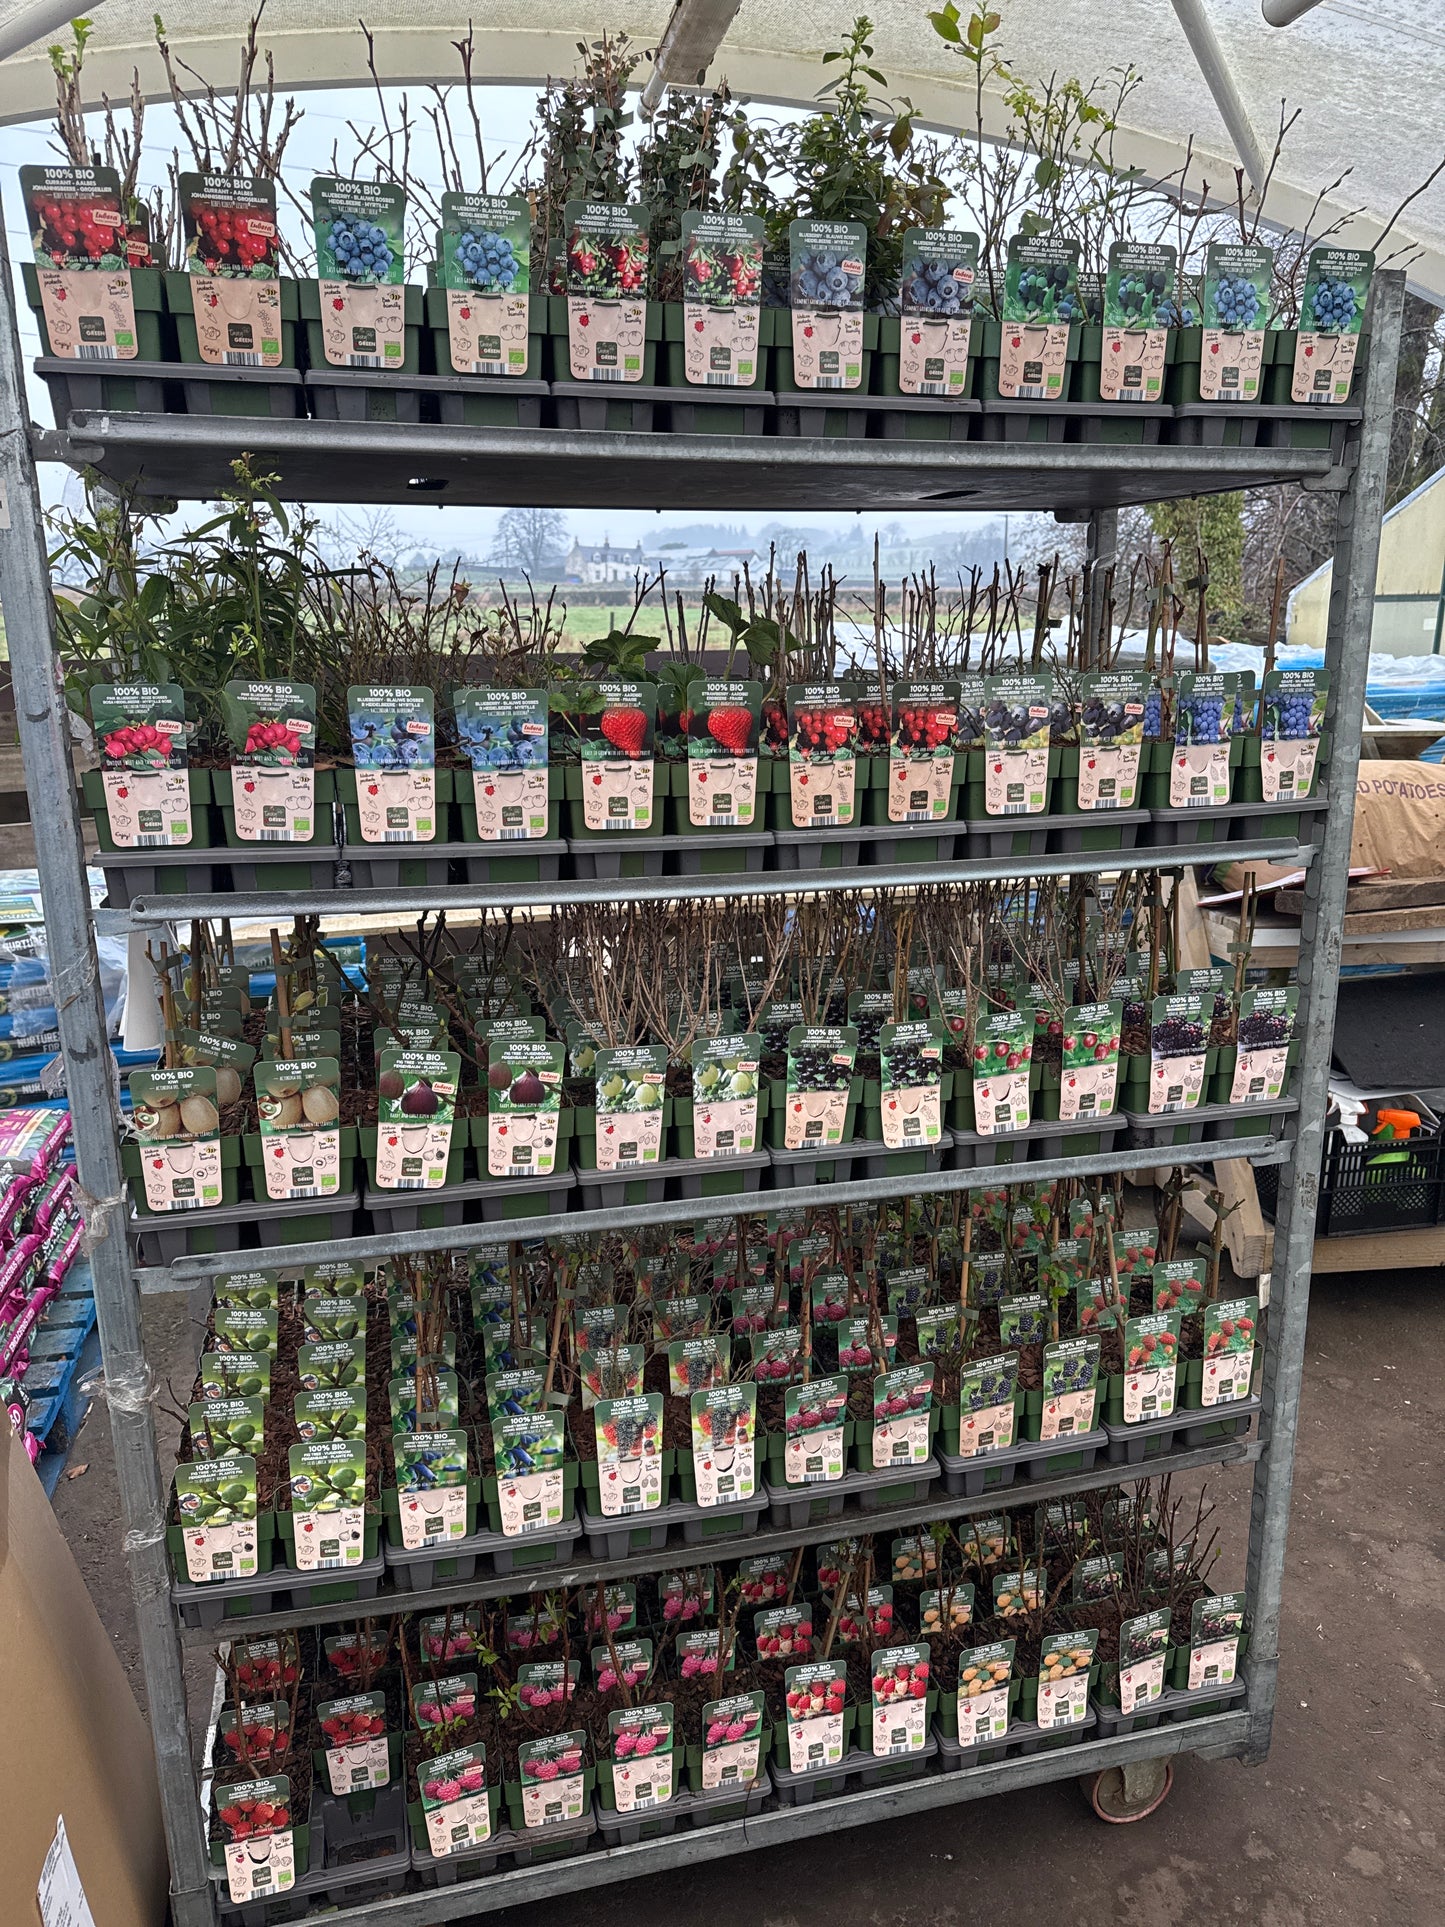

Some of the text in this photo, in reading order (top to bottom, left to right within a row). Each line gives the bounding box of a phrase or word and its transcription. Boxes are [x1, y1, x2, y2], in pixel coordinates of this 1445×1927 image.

[44, 168, 95, 180] 100% BIO
[203, 177, 253, 190] 100% BIO
[335, 182, 381, 196] 100% BIO
[464, 196, 509, 209] 100% BIO
[586, 204, 628, 217] 100% BIO
[702, 215, 743, 227] 100% BIO
[810, 224, 848, 234] 100% BIO
[925, 231, 962, 243] 100% BIO
[1028, 237, 1064, 248] 100% BIO
[1128, 244, 1161, 255] 100% BIO
[1225, 247, 1258, 257] 100% BIO
[1328, 251, 1360, 262] 100% BIO
[1100, 675, 1134, 684] 100% BIO
[1212, 675, 1224, 683] BIO
[1302, 671, 1314, 679] BIO
[1002, 677, 1036, 686] 100% BIO
[113, 687, 159, 696] 100% BIO
[248, 685, 293, 694] 100% BIO
[622, 685, 637, 693] BIO
[706, 684, 744, 692] 100% BIO
[805, 686, 840, 695] 100% BIO
[910, 684, 945, 693] 100% BIO
[369, 689, 412, 697] 100% BIO
[486, 692, 527, 701] 100% BIO
[1372, 779, 1445, 800] POTATOES
[1274, 989, 1286, 997] BIO
[1080, 1006, 1097, 1014] 100%
[896, 1023, 928, 1033] 100% BIO
[709, 1039, 729, 1047] 100%
[509, 1044, 547, 1052] 100% BIO
[426, 1053, 441, 1061] BIO
[275, 1061, 317, 1072] 100% BIO
[151, 1071, 194, 1080] 100% BIO
[975, 1357, 1006, 1368] 100% BIO
[802, 1380, 833, 1392] 100% BIO
[708, 1387, 741, 1398] 100% BIO
[612, 1397, 647, 1408] 100% BIO
[510, 1414, 546, 1424] 100% BIO
[331, 1443, 346, 1451] BIO
[195, 1460, 235, 1471] 100% BIO
[1074, 1632, 1085, 1640] BIO
[334, 1698, 353, 1707] 100%
[624, 1707, 657, 1717] 100% BIO
[233, 1783, 255, 1792] 100%
